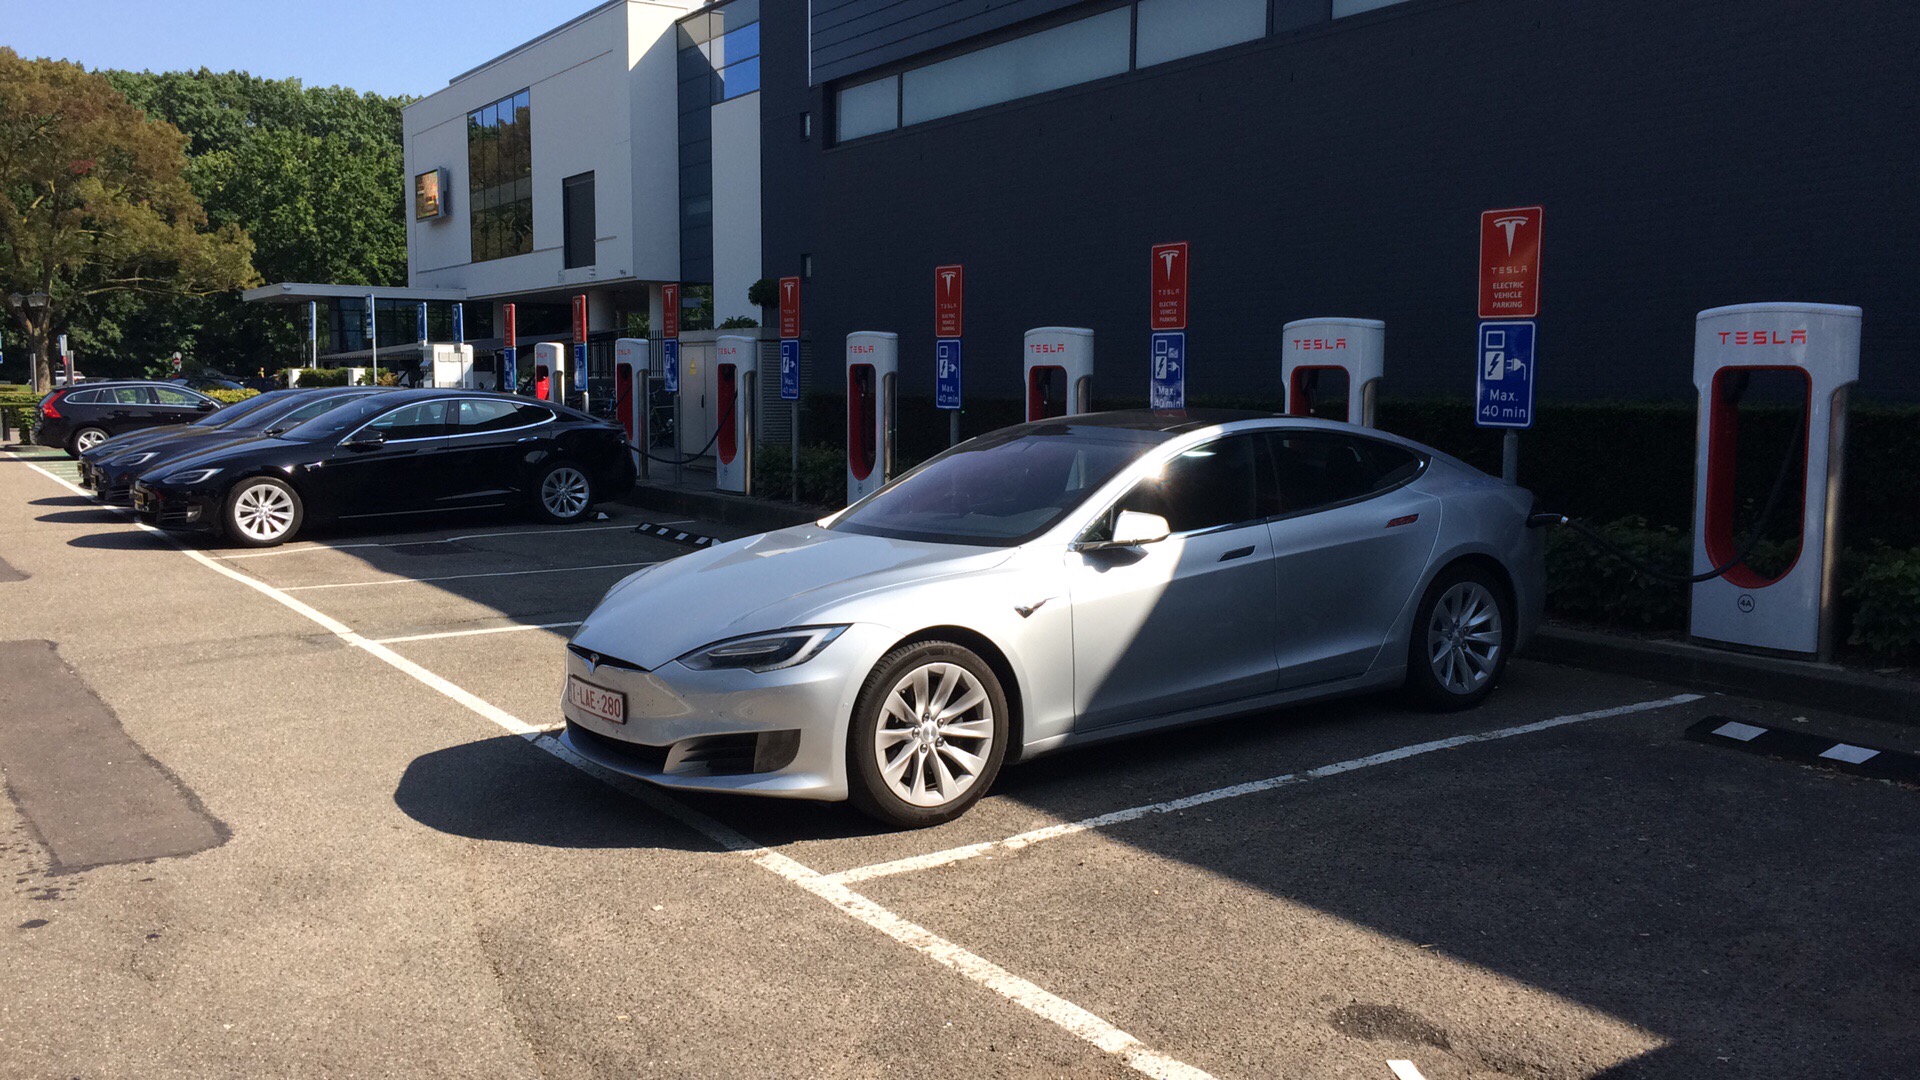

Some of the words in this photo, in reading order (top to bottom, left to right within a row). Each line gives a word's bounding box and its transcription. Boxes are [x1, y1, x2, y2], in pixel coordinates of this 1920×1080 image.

[1491, 265, 1528, 274] TESLA
[1492, 281, 1525, 290] ELECTRIC
[1493, 291, 1522, 299] VEHICLE
[1717, 329, 1808, 345] TESLA
[1029, 343, 1065, 353] TESLA
[1293, 338, 1347, 350] TESLA
[849, 345, 874, 354] TESLA
[1158, 385, 1176, 396] Max.
[1489, 388, 1519, 401] Max.
[1153, 398, 1165, 408] 40
[1166, 399, 1181, 408] min
[1481, 405, 1499, 417] 40
[1502, 406, 1526, 418] min
